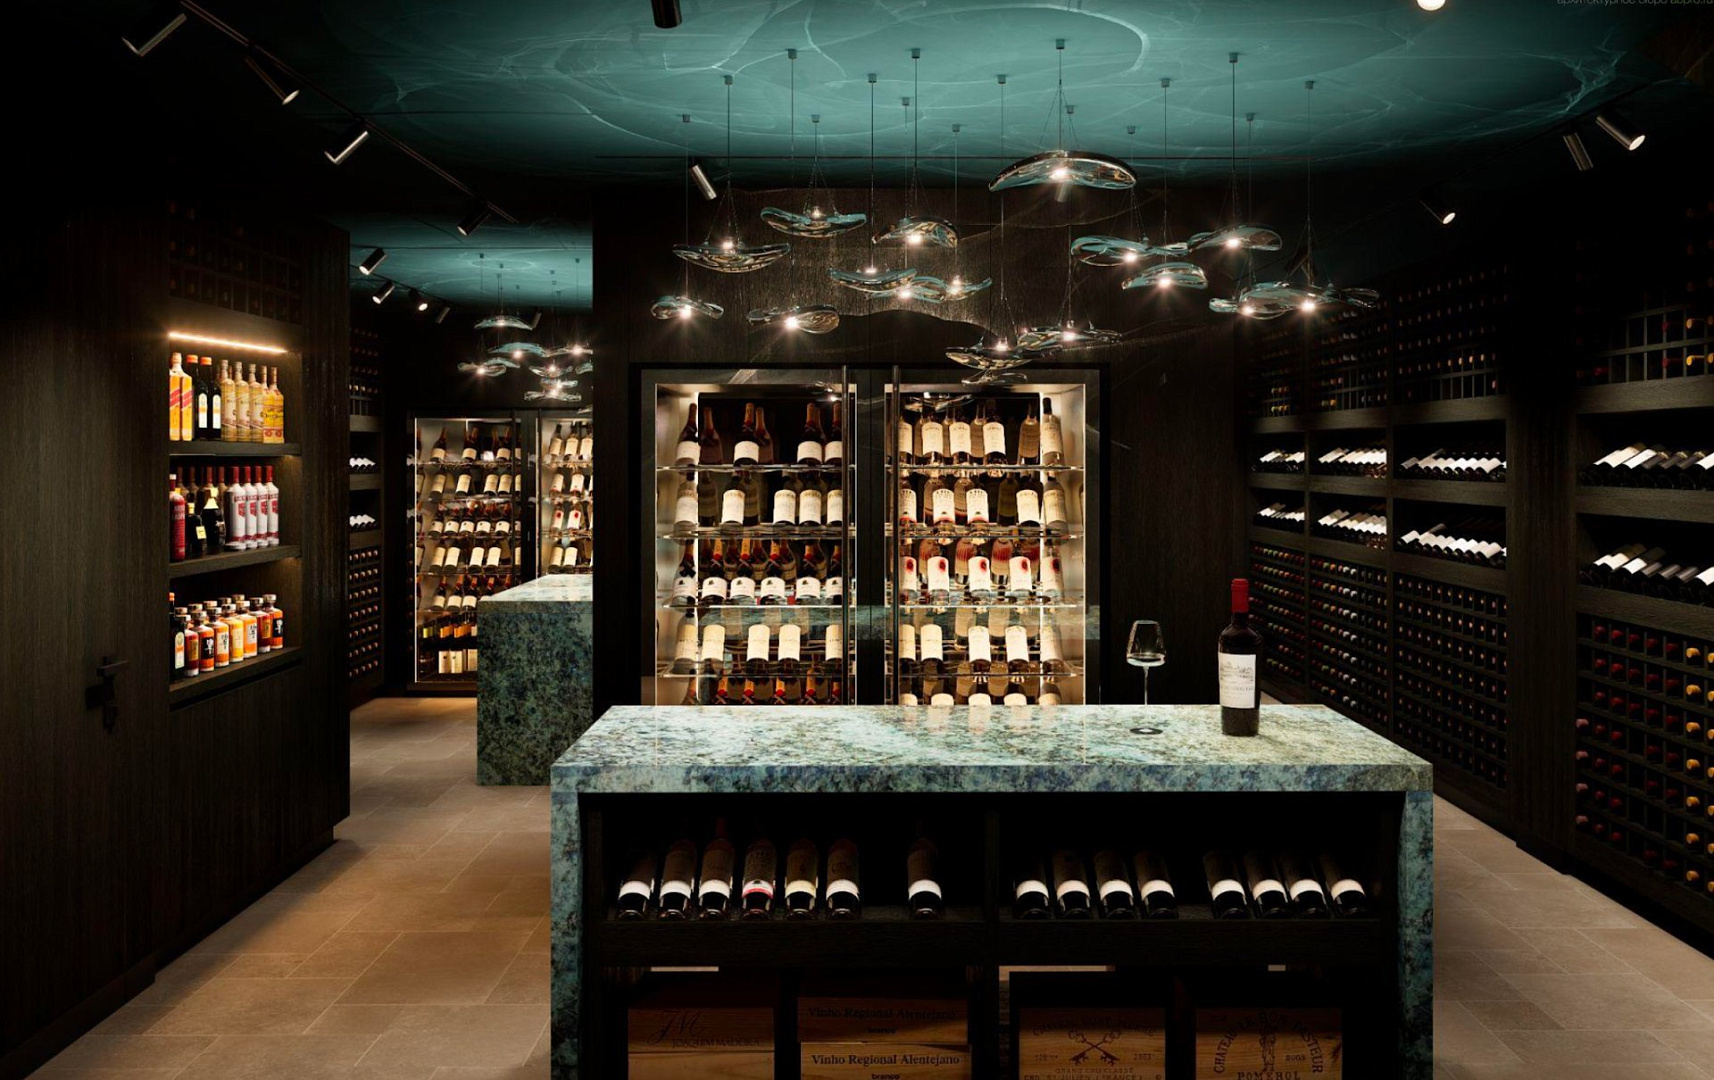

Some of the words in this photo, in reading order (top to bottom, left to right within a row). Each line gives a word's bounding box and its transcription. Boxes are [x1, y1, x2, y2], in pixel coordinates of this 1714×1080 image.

[812, 1055, 845, 1064] Vinho
[848, 1055, 896, 1067] Regional
[900, 1055, 959, 1067] Alentejano
[1238, 1071, 1300, 1080] POMEROL
